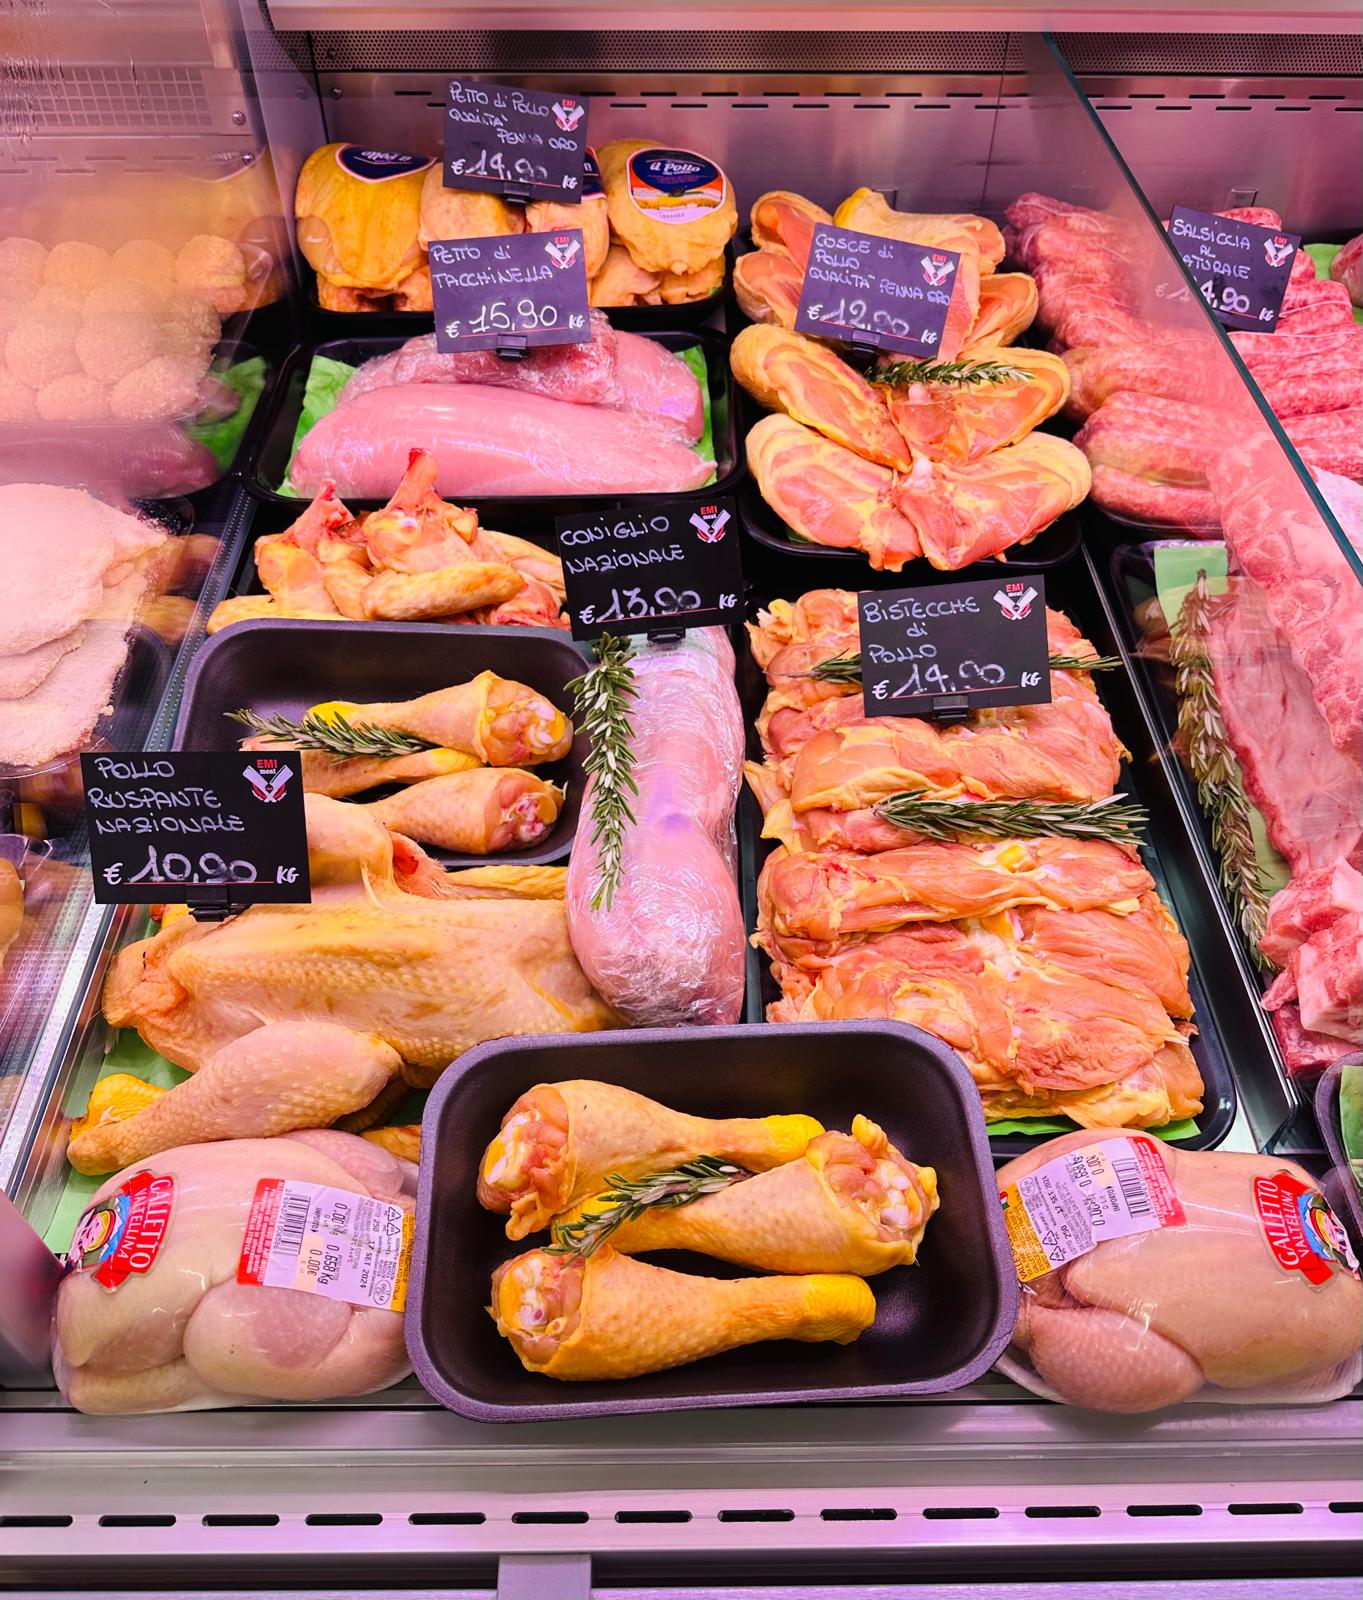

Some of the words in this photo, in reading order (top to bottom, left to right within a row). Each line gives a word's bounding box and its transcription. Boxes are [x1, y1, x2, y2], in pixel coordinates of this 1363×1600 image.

[450, 82, 488, 104] PETTO
[494, 96, 507, 108] di
[512, 92, 549, 116] POLLO
[561, 99, 576, 107] EMI
[549, 138, 577, 151] ORO
[451, 159, 466, 175] €
[562, 175, 577, 189] KG
[664, 163, 700, 172] Pollo
[1173, 219, 1250, 250] SALSICCIA
[1274, 236, 1287, 245] EMI
[430, 245, 481, 264] PETTO
[494, 245, 510, 260] di
[816, 233, 871, 253] COSCE
[878, 246, 893, 259] di
[1200, 244, 1215, 258] AL
[814, 249, 860, 270] POLLO
[932, 254, 947, 263] EMI
[433, 265, 553, 288] TACCHINELLA
[880, 279, 923, 300] PENNA
[927, 291, 950, 305] ORO
[445, 321, 460, 338] €
[469, 300, 557, 333] 15,90
[568, 315, 585, 328] KG
[807, 304, 823, 320] €
[921, 329, 937, 344] KG
[1259, 308, 1274, 321] KG
[700, 506, 717, 515] EMI
[560, 514, 669, 546] CONIGLIO
[565, 544, 684, 575] NAZIONALE
[1006, 583, 1024, 592] EMI
[579, 605, 595, 624] €
[718, 594, 738, 609] KG
[864, 597, 980, 623] BISTECCHE
[906, 622, 928, 637] di
[868, 643, 937, 665] POLLO
[872, 680, 890, 700] €
[1021, 672, 1042, 688] KG
[95, 757, 175, 779] POLLO
[257, 759, 277, 768] EMI
[87, 787, 222, 810] RUSPANTE
[96, 813, 245, 834] NAZIONALE
[103, 863, 123, 885] €
[128, 845, 257, 883] 10,90
[276, 866, 299, 884] KG
[1041, 1174, 1052, 1189] 2024
[1047, 1190, 1058, 1203] SET
[1105, 1188, 1120, 1212] IMPORTO
[1054, 1204, 1063, 1213] 17
[117, 1187, 147, 1259] VALTELLINA
[129, 1179, 171, 1269] GALLETTO
[1060, 1224, 1072, 1238] 250
[1257, 1180, 1300, 1266] GALLETTO
[1281, 1189, 1310, 1258] VALTELLINA
[321, 1243, 340, 1272] 0.658
[363, 1251, 372, 1265] SET
[316, 1271, 333, 1285] Kg
[359, 1268, 369, 1288] 2024
